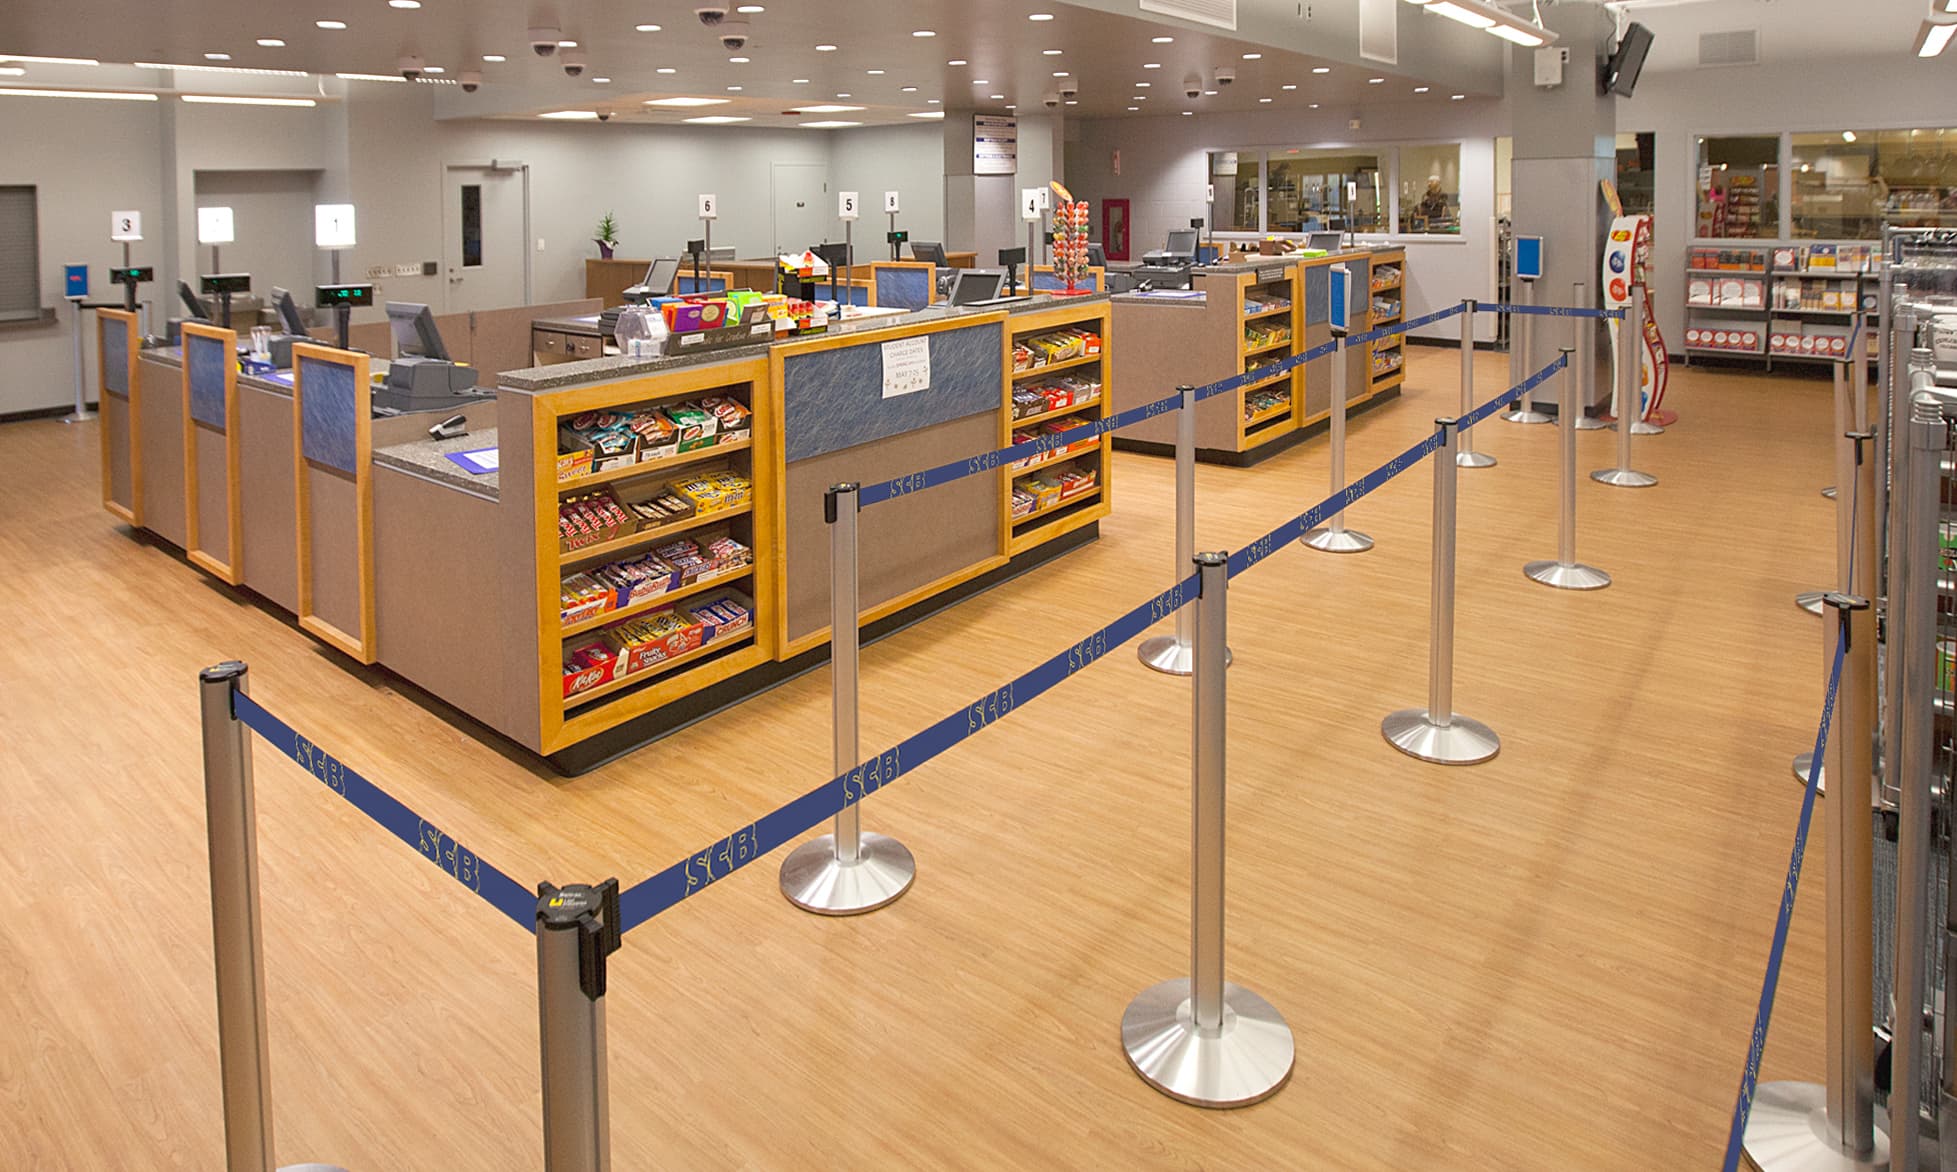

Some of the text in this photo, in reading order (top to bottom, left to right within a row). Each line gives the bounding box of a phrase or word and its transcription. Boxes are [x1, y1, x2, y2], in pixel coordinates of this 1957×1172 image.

[704, 200, 711, 212] 6
[845, 198, 853, 212] 5
[1029, 199, 1035, 213] 4
[121, 218, 132, 232] 3
